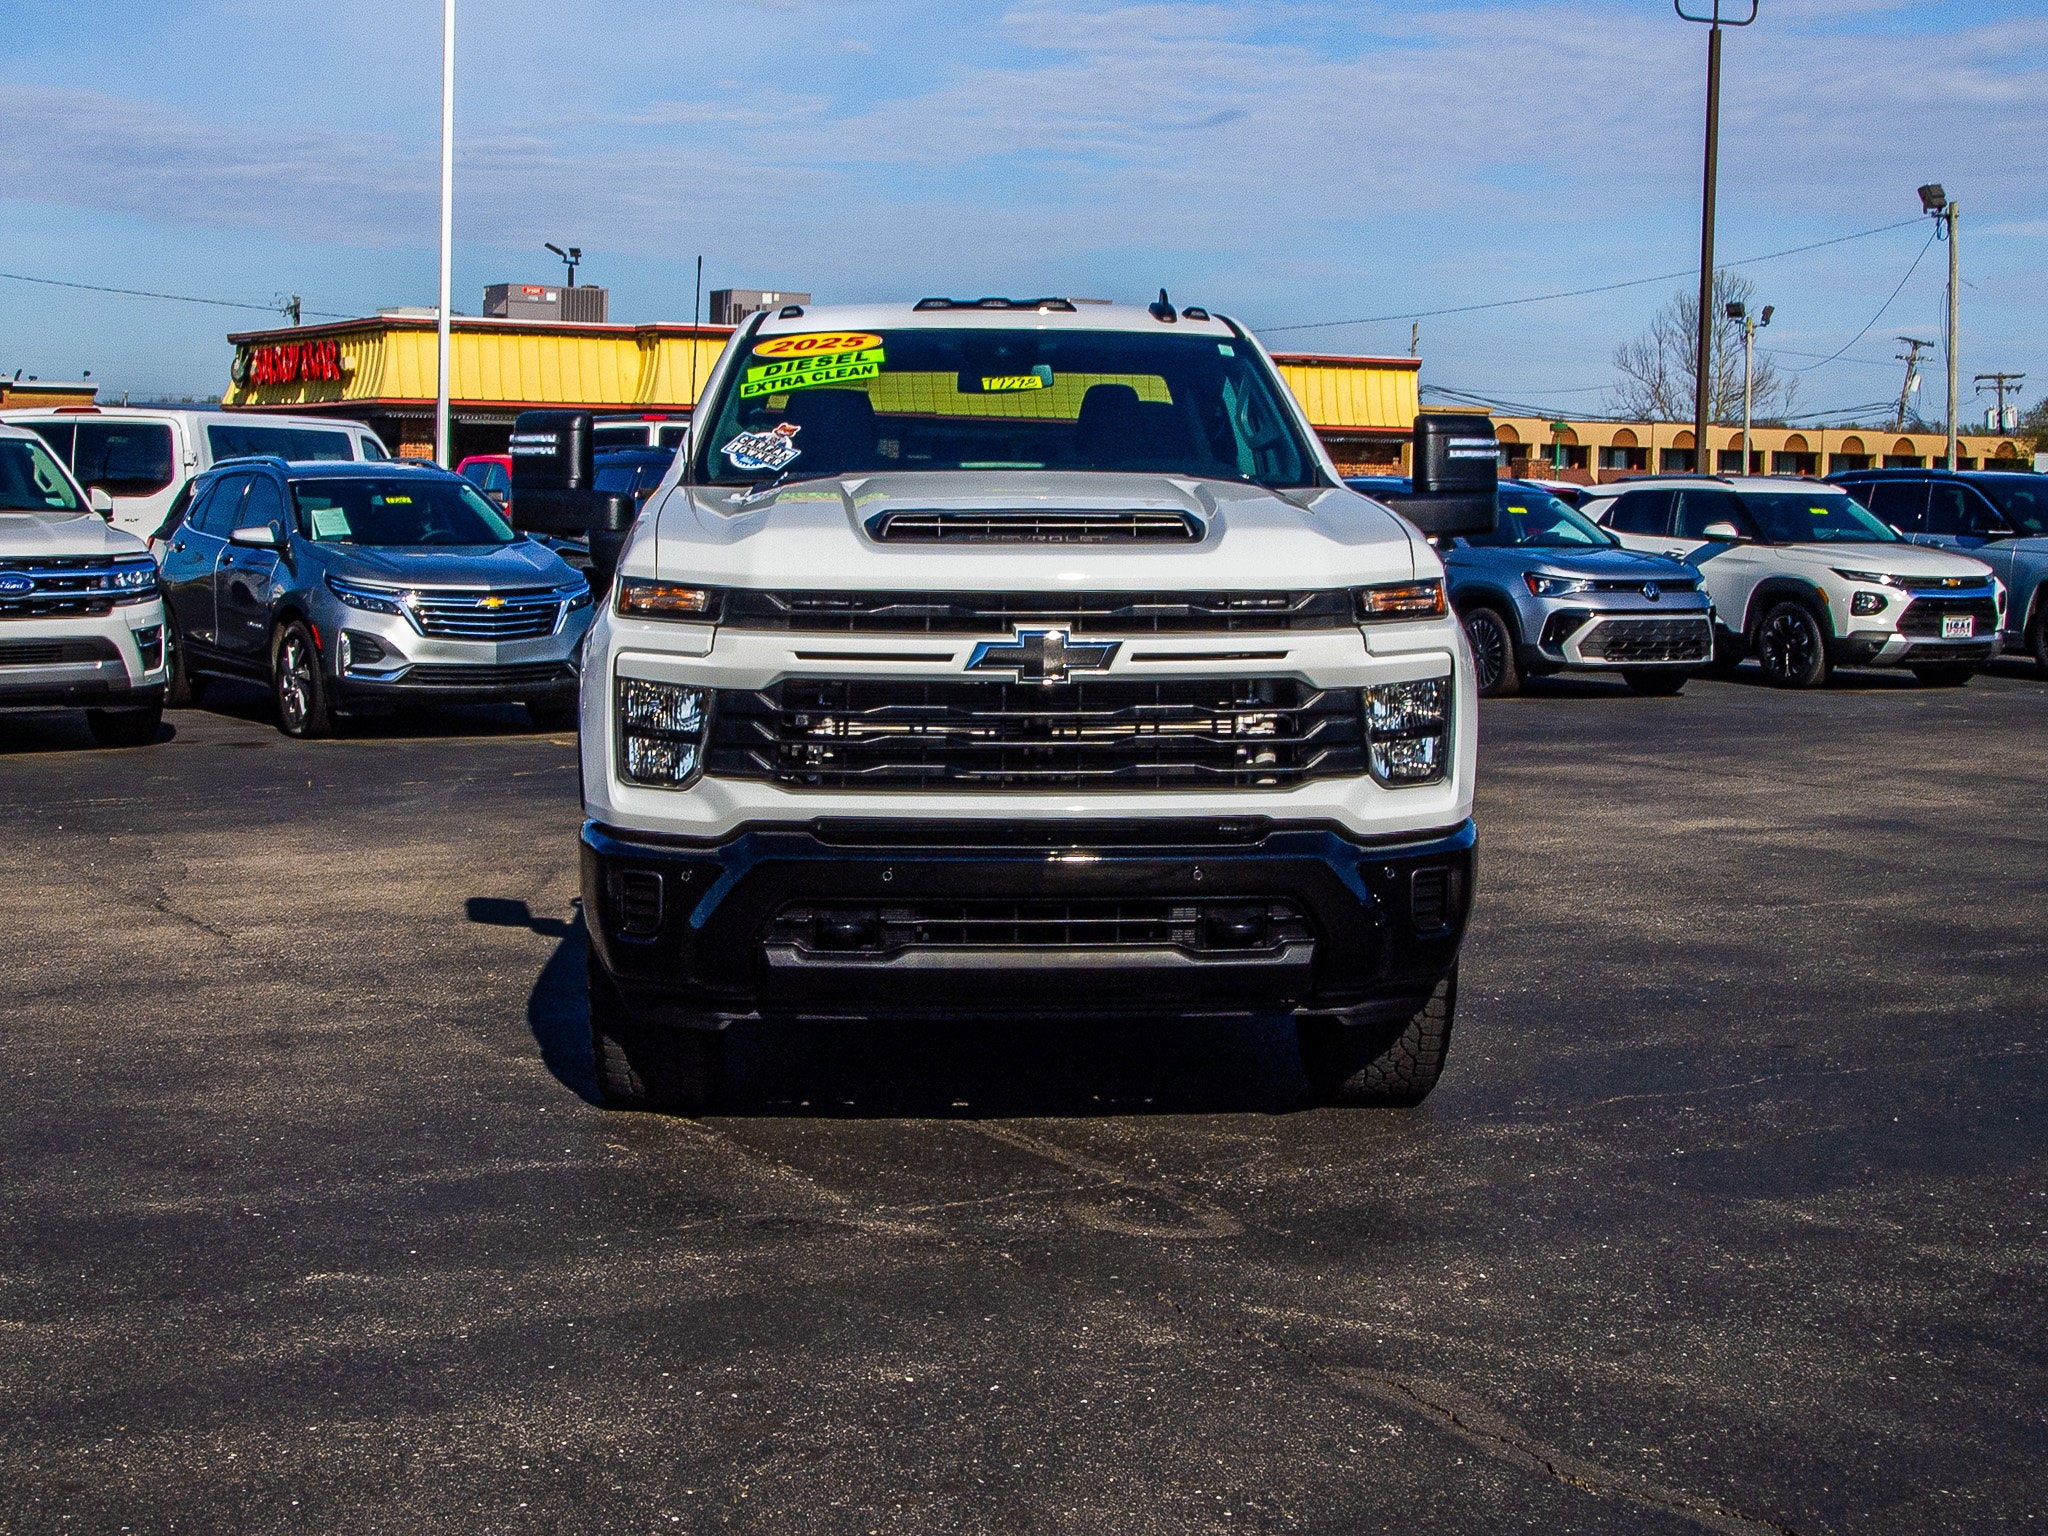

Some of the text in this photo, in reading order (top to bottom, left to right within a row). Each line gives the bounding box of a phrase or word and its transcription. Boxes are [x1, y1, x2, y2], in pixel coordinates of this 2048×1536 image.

[766, 336, 868, 354] 2025
[301, 339, 340, 382] BAR
[763, 351, 869, 378] DIESEL
[743, 364, 874, 396] EXTRA CLEAN
[738, 445, 783, 466] OWNER
[740, 436, 796, 462] CARFAX
